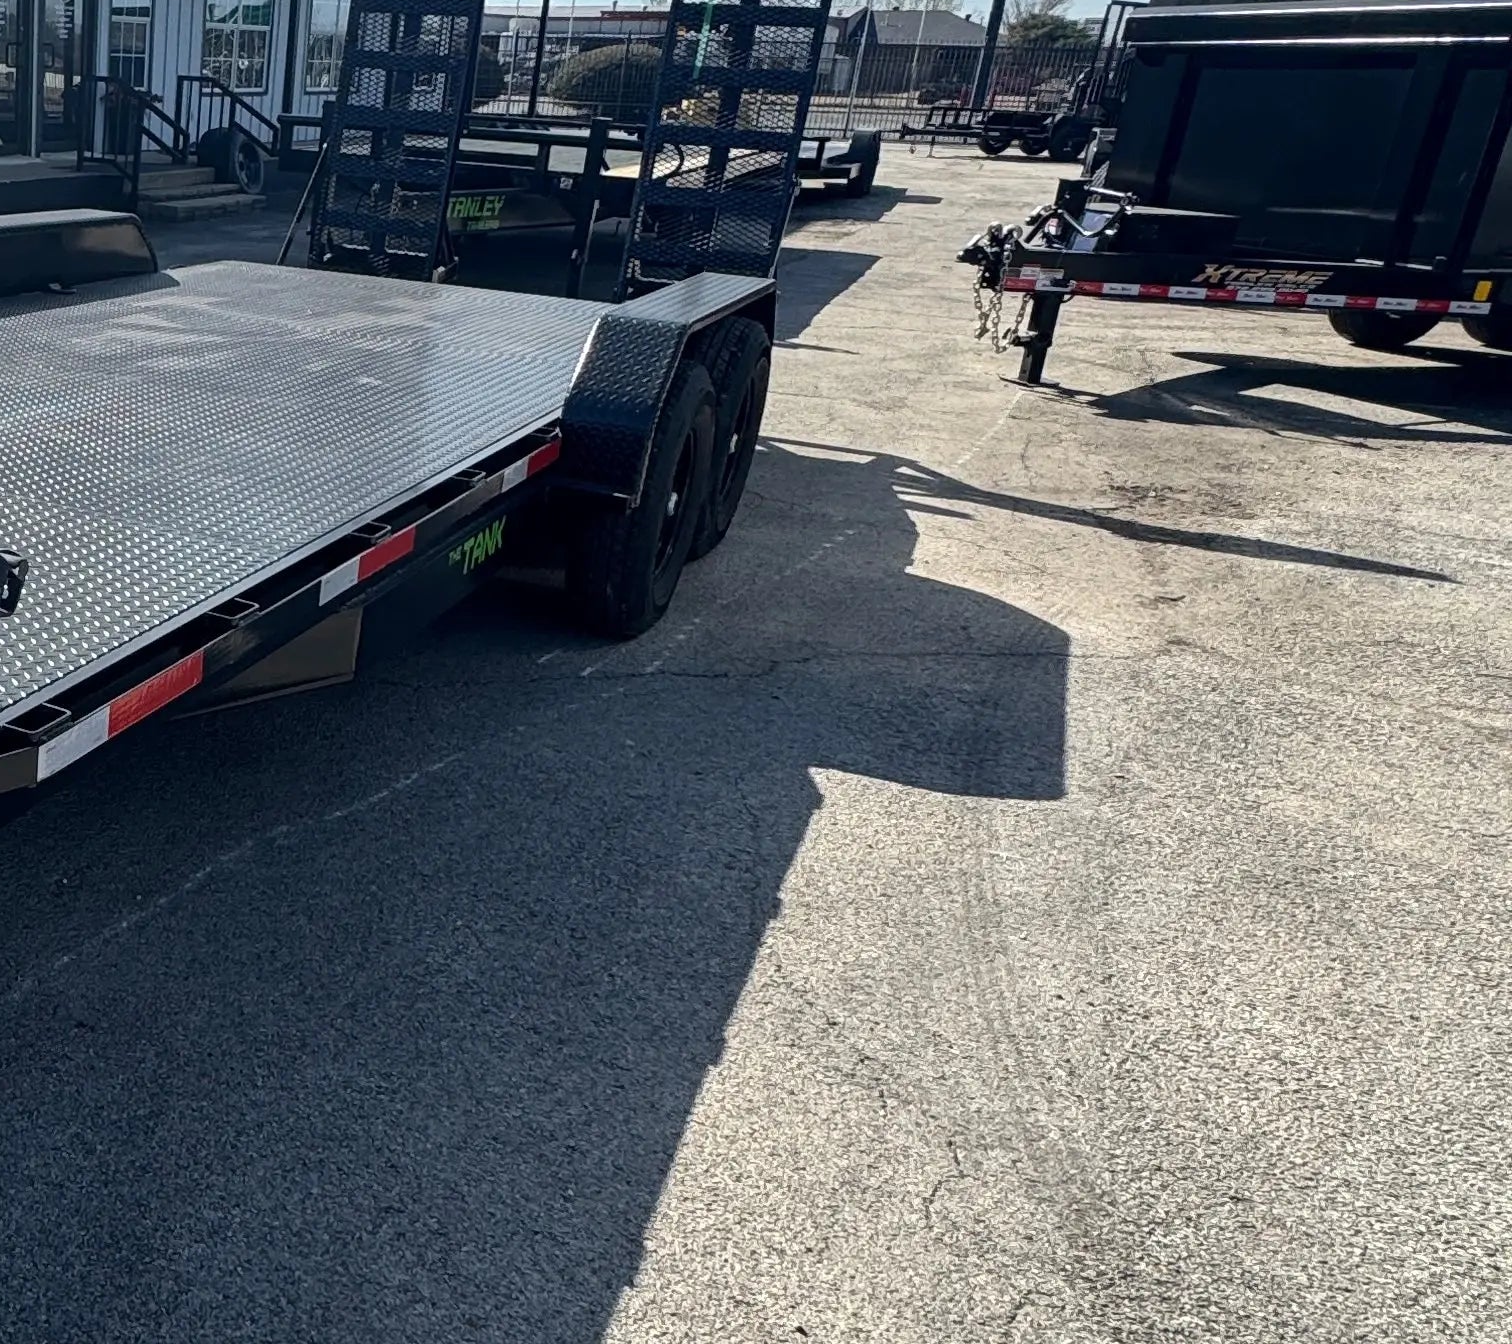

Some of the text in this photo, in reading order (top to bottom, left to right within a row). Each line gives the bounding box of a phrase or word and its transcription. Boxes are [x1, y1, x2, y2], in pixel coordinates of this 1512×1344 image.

[447, 195, 506, 218] TANLEY
[1190, 263, 1335, 285] XTREME
[463, 515, 507, 575] TANK
